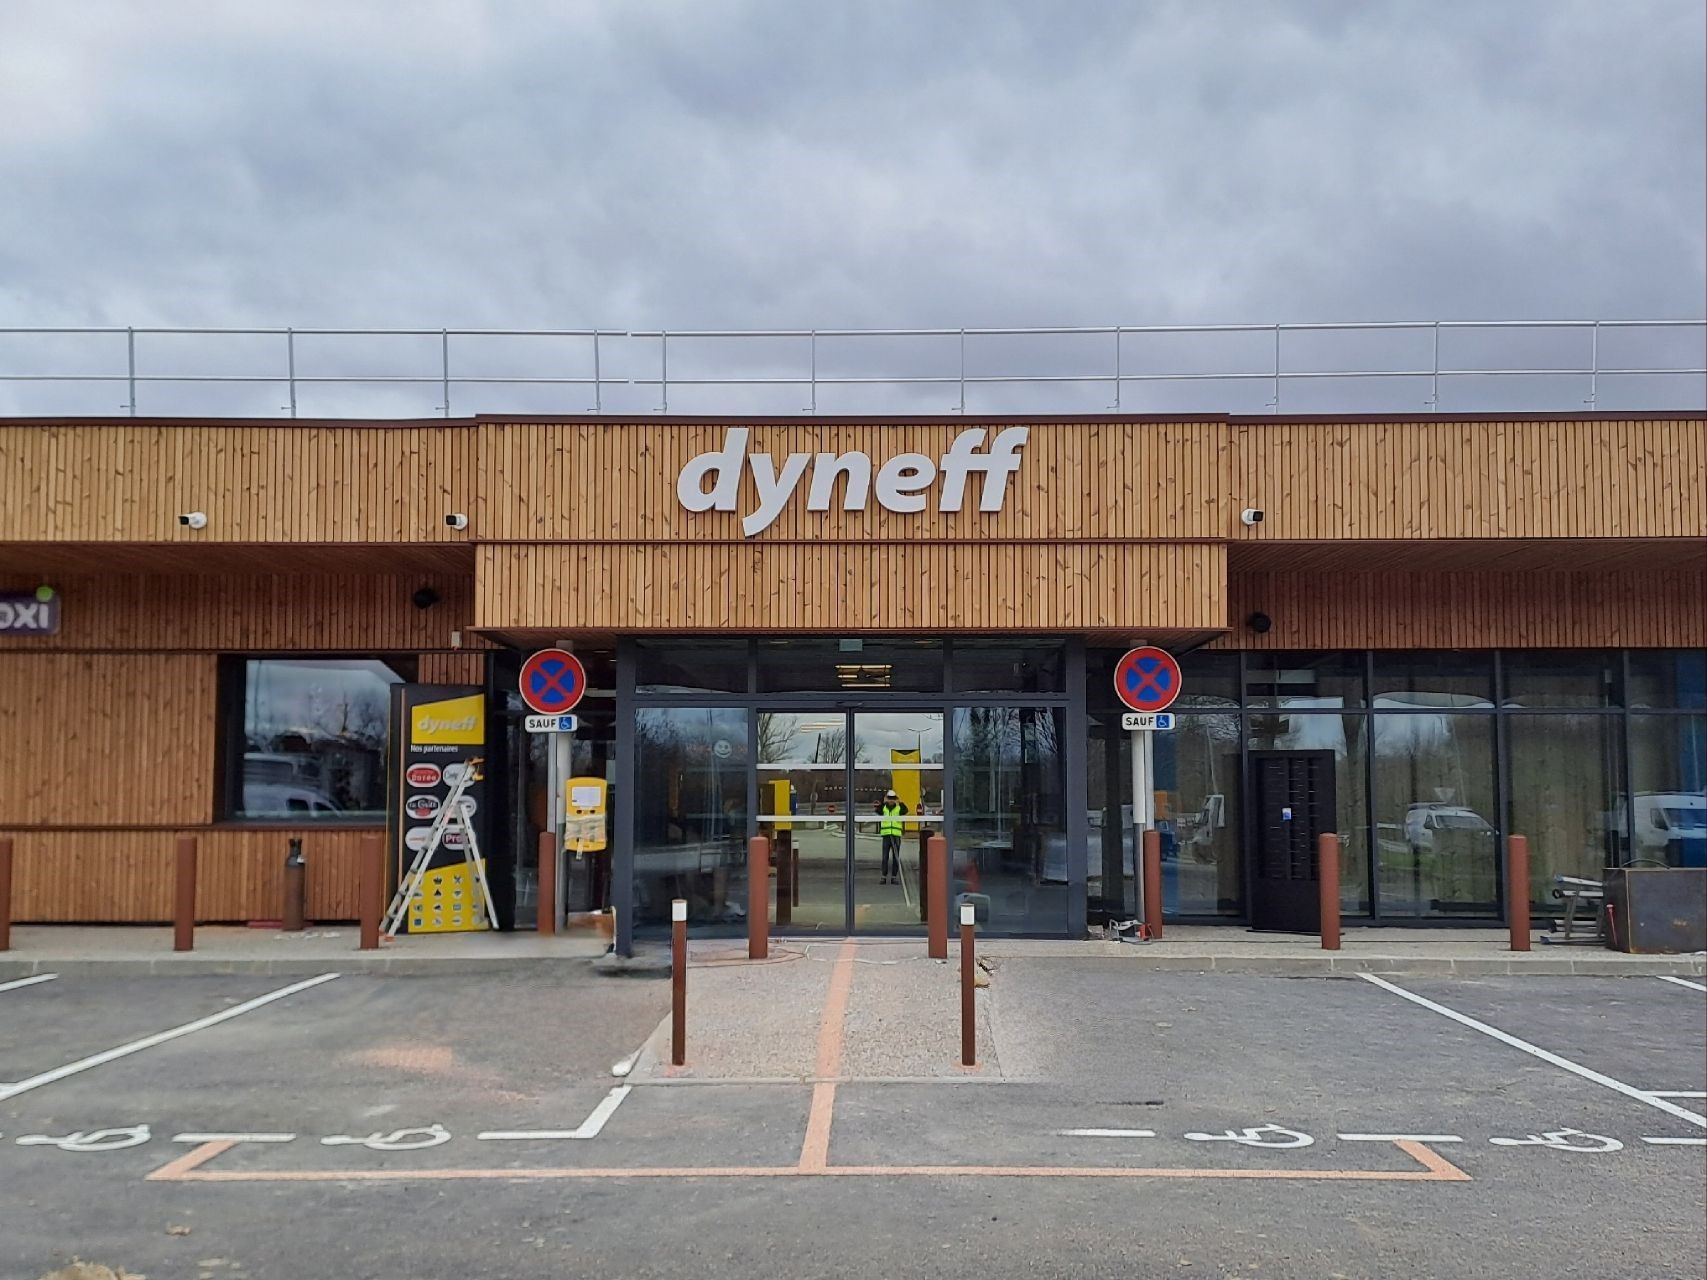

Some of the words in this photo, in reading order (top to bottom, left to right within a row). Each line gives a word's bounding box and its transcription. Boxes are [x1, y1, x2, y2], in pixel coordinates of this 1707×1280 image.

[676, 426, 1029, 537] dyneff
[418, 715, 477, 734] dyneff
[529, 719, 556, 728] SAUF
[1125, 716, 1154, 726] SAUF
[411, 744, 422, 753] Nos
[423, 745, 458, 754] partenaires
